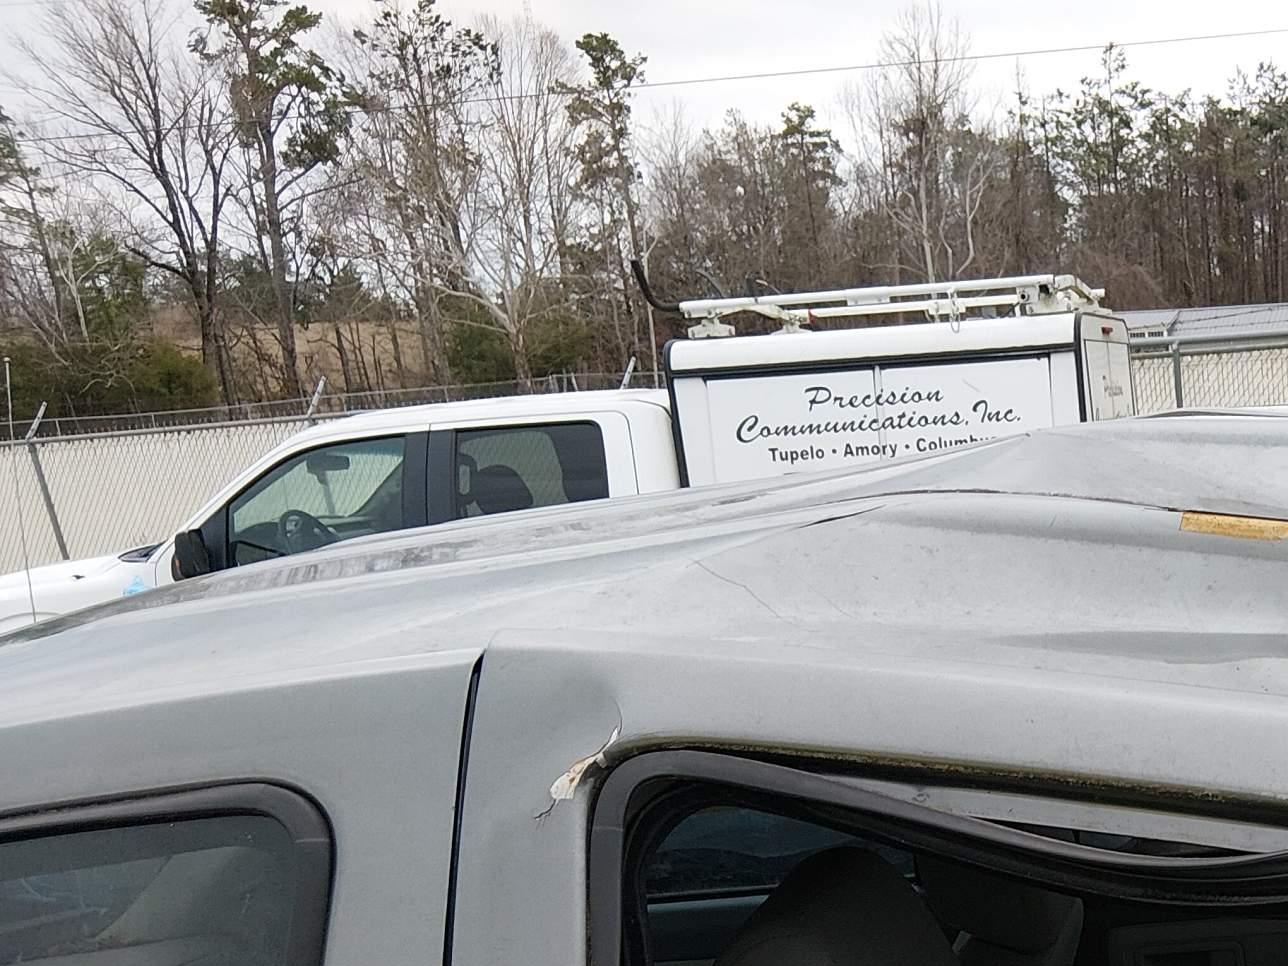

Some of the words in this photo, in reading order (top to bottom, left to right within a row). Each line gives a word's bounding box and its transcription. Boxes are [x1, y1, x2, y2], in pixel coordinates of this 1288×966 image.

[804, 386, 944, 412] Precision
[735, 409, 970, 444] Communications,
[971, 399, 1021, 424] Inc.
[768, 445, 825, 465] Tupelo
[843, 441, 898, 459] Amory
